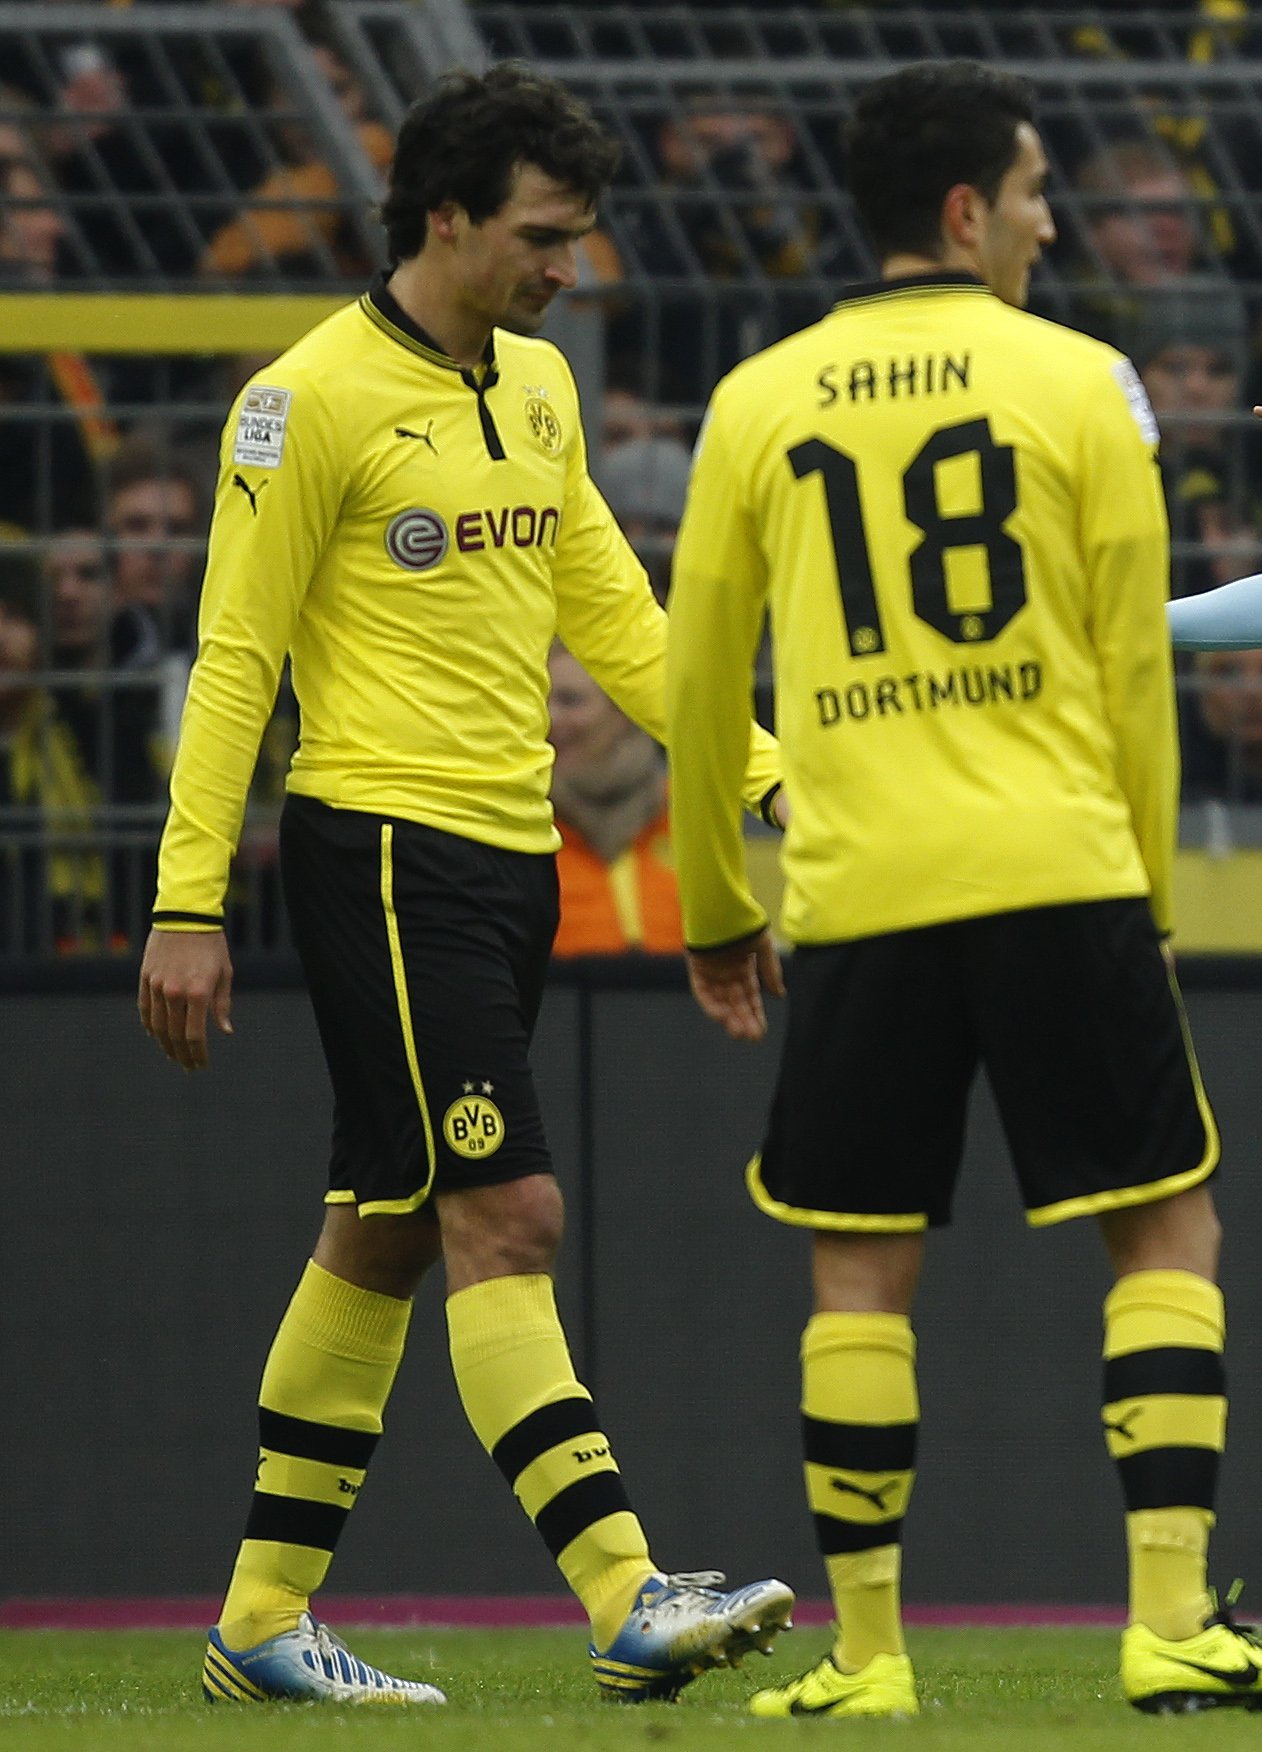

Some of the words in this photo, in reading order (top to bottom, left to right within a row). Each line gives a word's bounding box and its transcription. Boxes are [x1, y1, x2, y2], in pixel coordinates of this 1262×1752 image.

[816, 350, 972, 409] SAHIN
[786, 418, 1028, 657] 18
[815, 661, 1044, 728] DORTMUND
[453, 1104, 497, 1141] BVB
